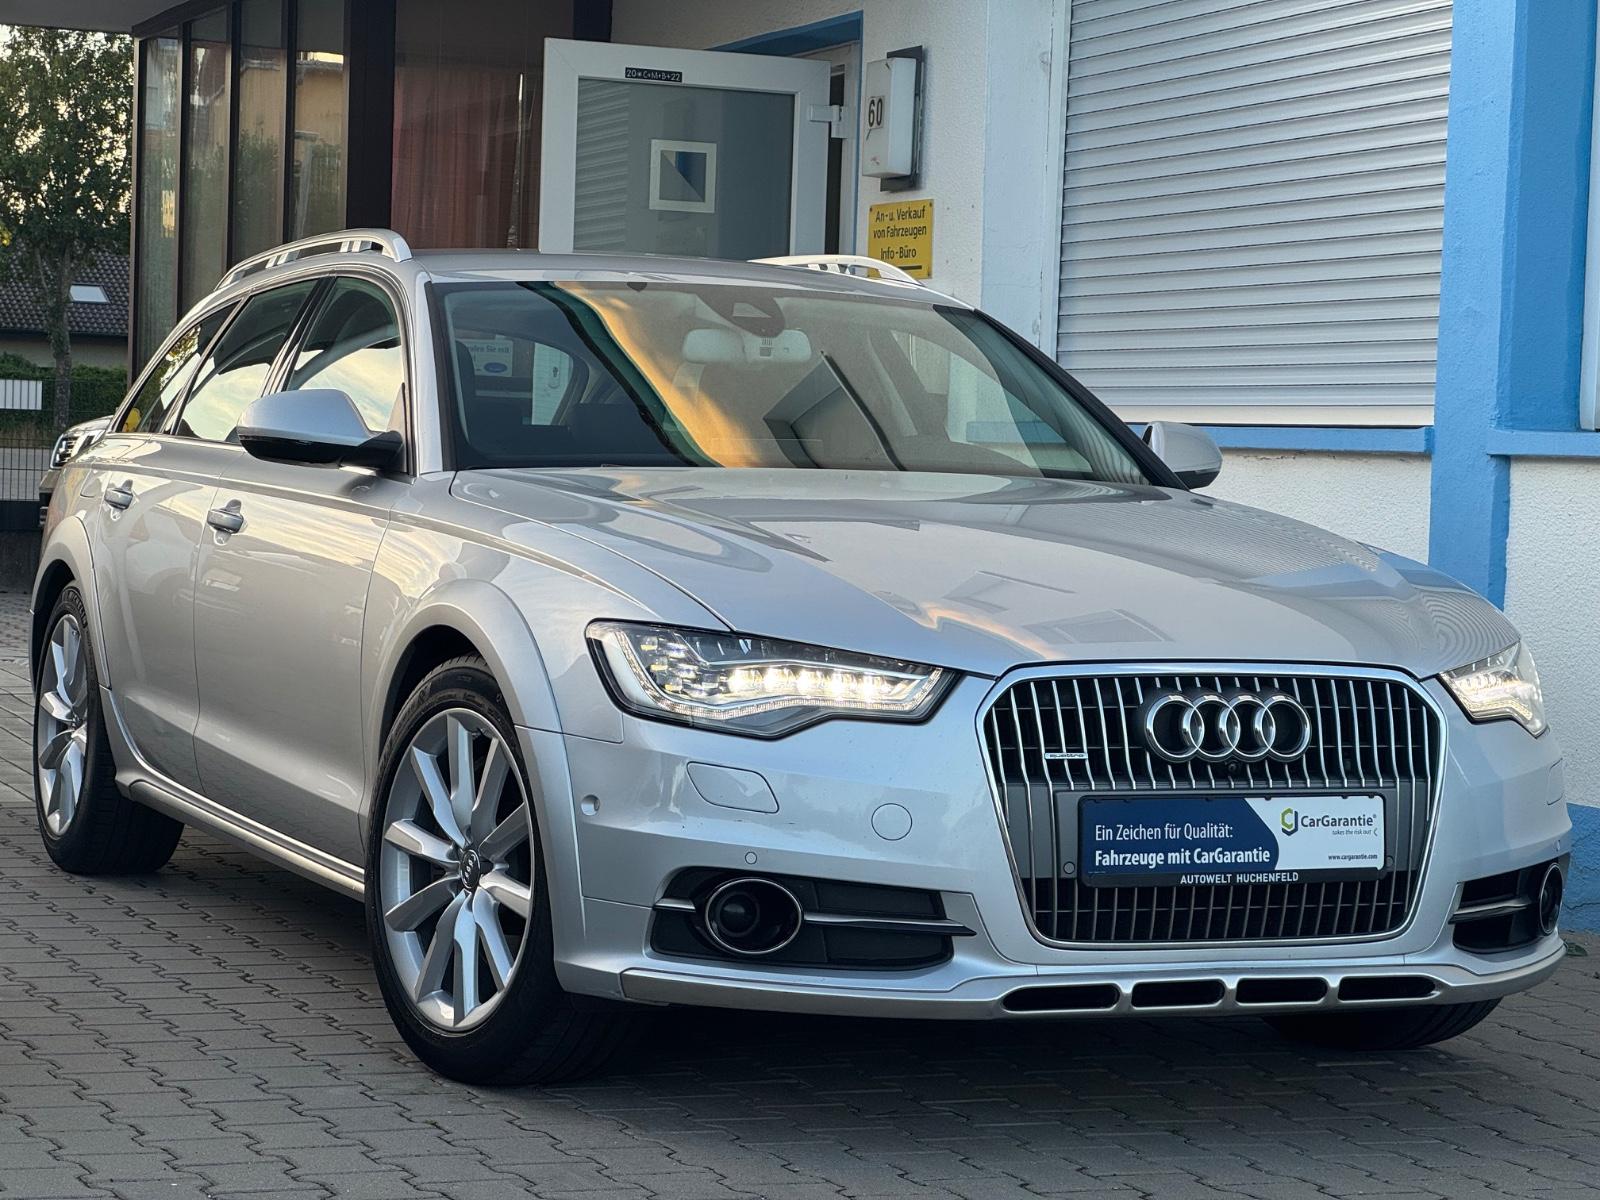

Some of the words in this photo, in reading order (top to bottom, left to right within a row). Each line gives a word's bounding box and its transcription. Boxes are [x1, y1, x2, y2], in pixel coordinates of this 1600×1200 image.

[868, 98, 883, 127] 60
[896, 205, 926, 220] Verkauf
[873, 229, 885, 239] von
[886, 225, 927, 240] Fahrzeugen
[1095, 824, 1113, 841] Ein
[1116, 823, 1162, 841] Zeichen
[1164, 822, 1181, 840] für
[1184, 822, 1233, 841] Qualität:
[1095, 849, 1165, 869] Fahrzeuge
[1168, 848, 1191, 865] mit
[1193, 846, 1270, 864] CarGarantie
[1328, 853, 1378, 861] www.cargarantie.com
[1180, 873, 1232, 885] AUTOWELT
[1236, 872, 1299, 883] HUCHENFELD
